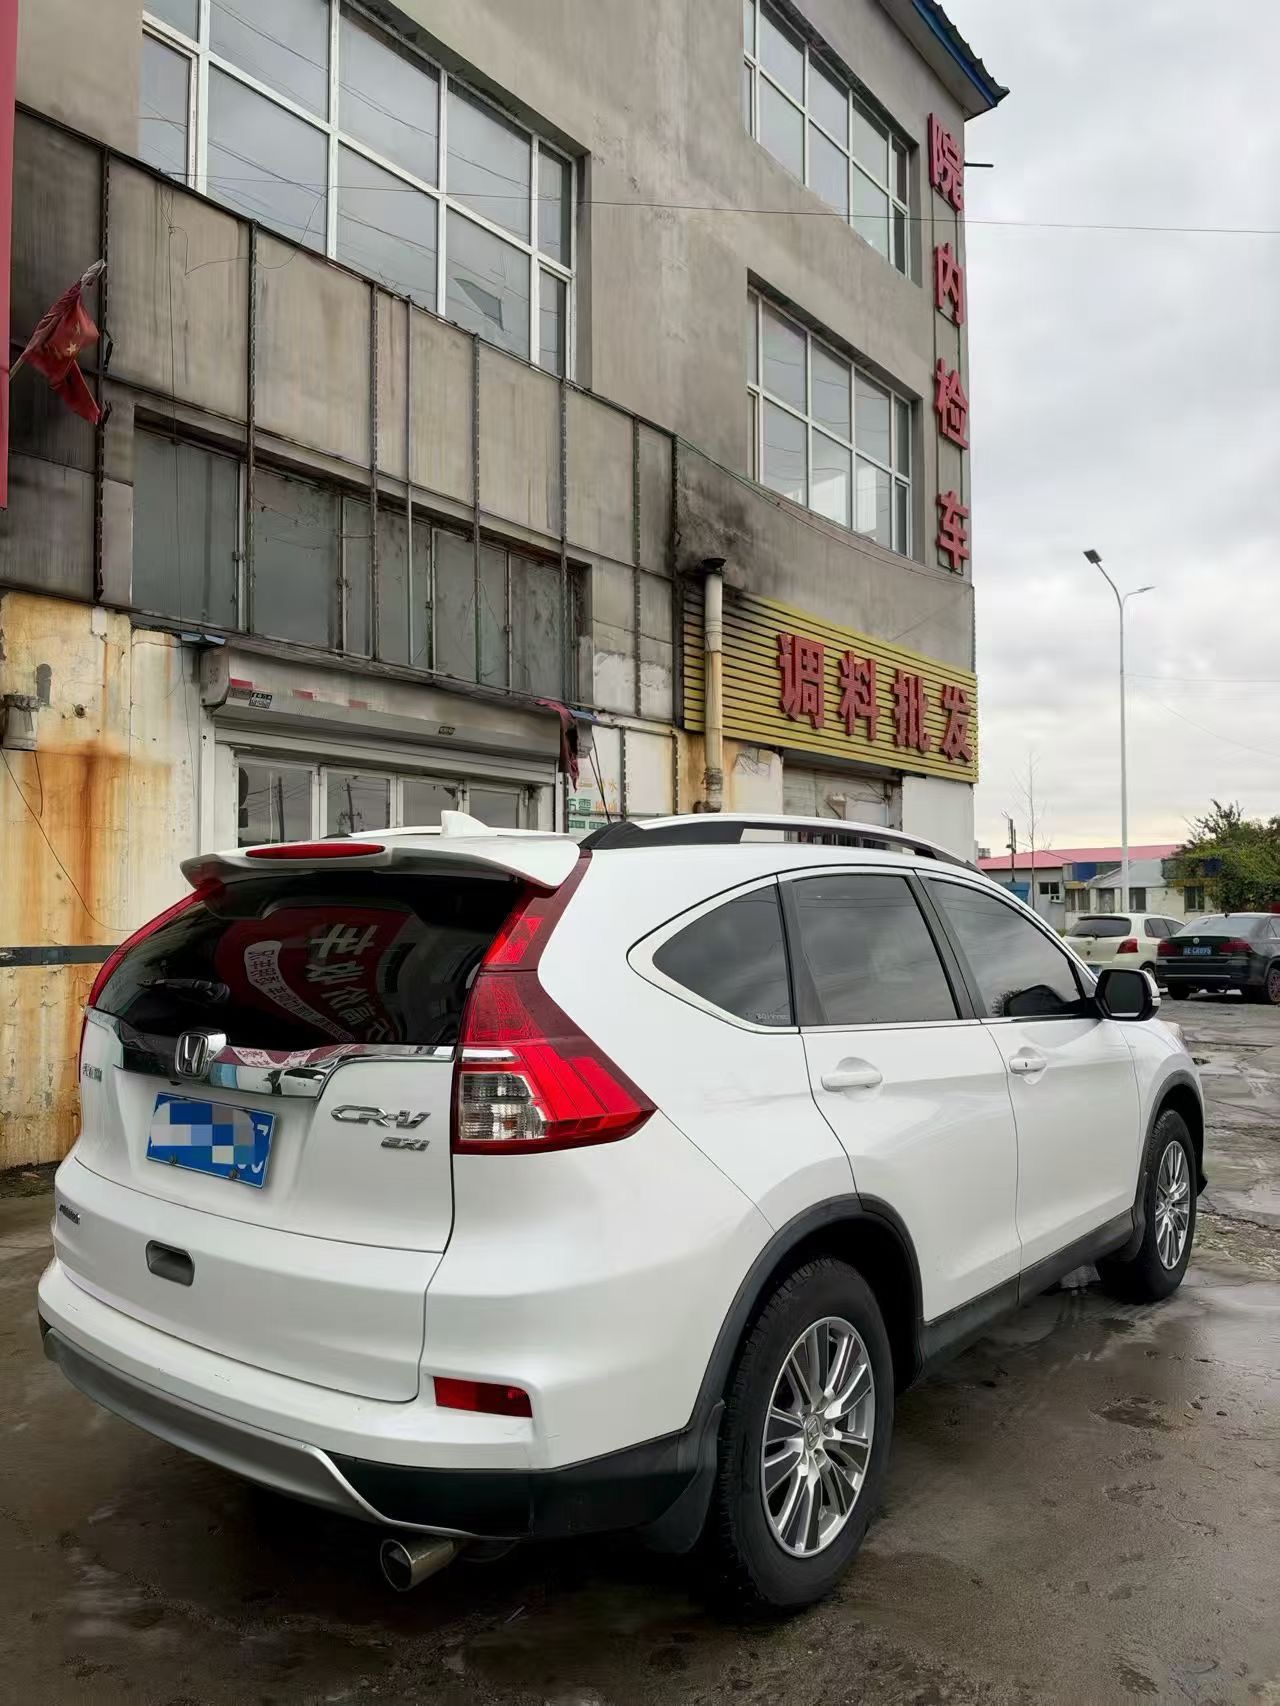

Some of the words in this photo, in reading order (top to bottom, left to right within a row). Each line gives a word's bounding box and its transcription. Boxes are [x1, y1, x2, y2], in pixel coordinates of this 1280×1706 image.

[928, 112, 970, 569] 院内检车
[776, 632, 972, 762] 调料批发
[331, 1105, 431, 1129] CR-V
